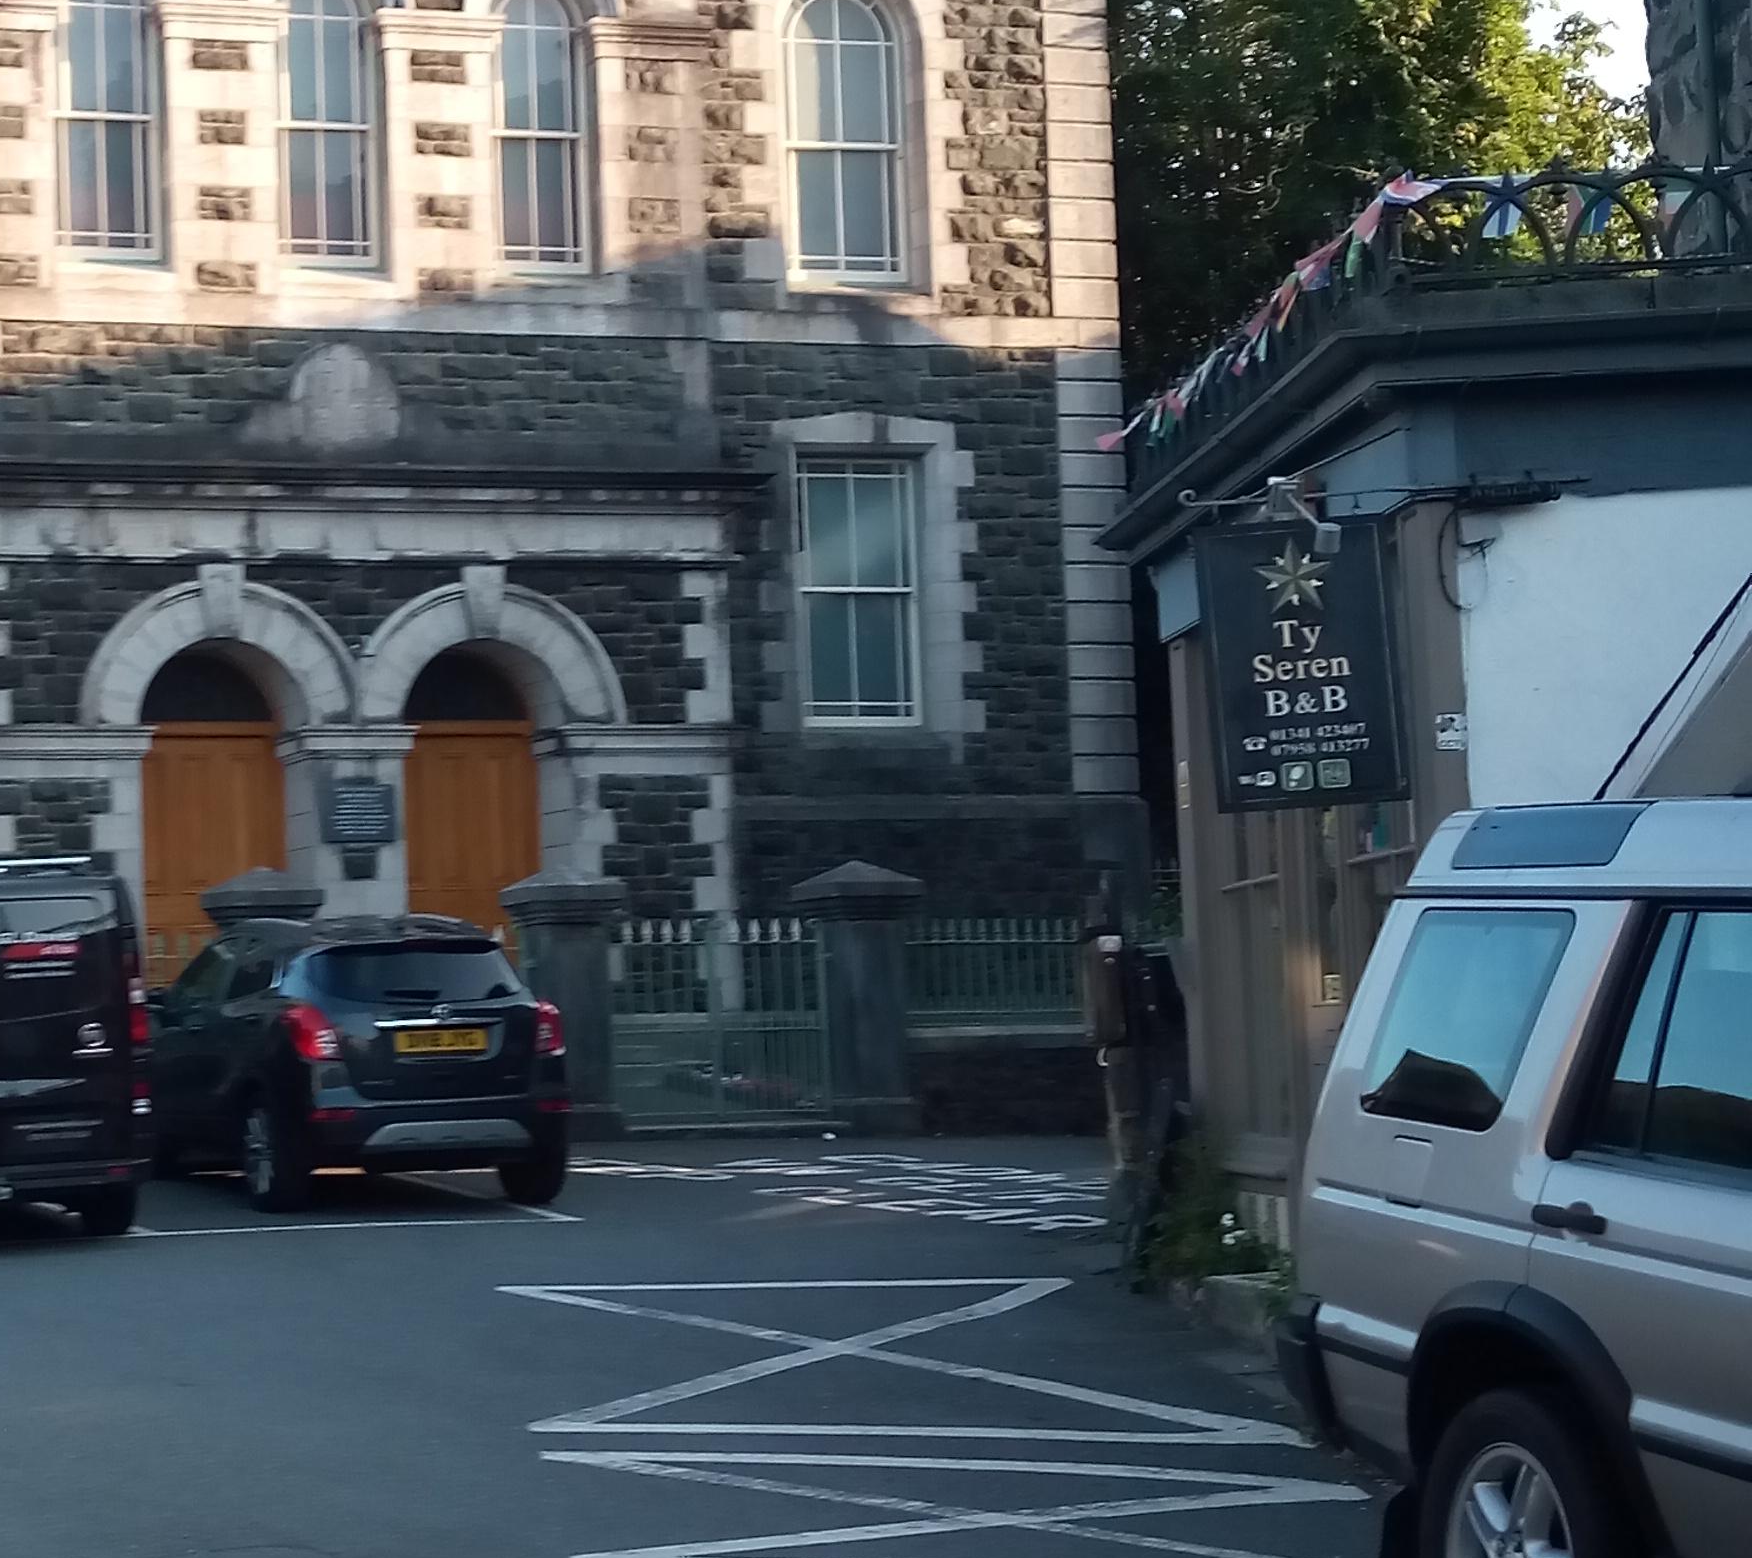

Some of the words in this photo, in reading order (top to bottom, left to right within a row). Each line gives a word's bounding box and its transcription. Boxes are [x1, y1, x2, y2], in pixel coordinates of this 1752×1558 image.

[1273, 619, 1323, 654] Ty
[1252, 654, 1352, 684] Seren
[1264, 686, 1349, 718] B&B
[750, 1186, 1109, 1231] CLEAR
